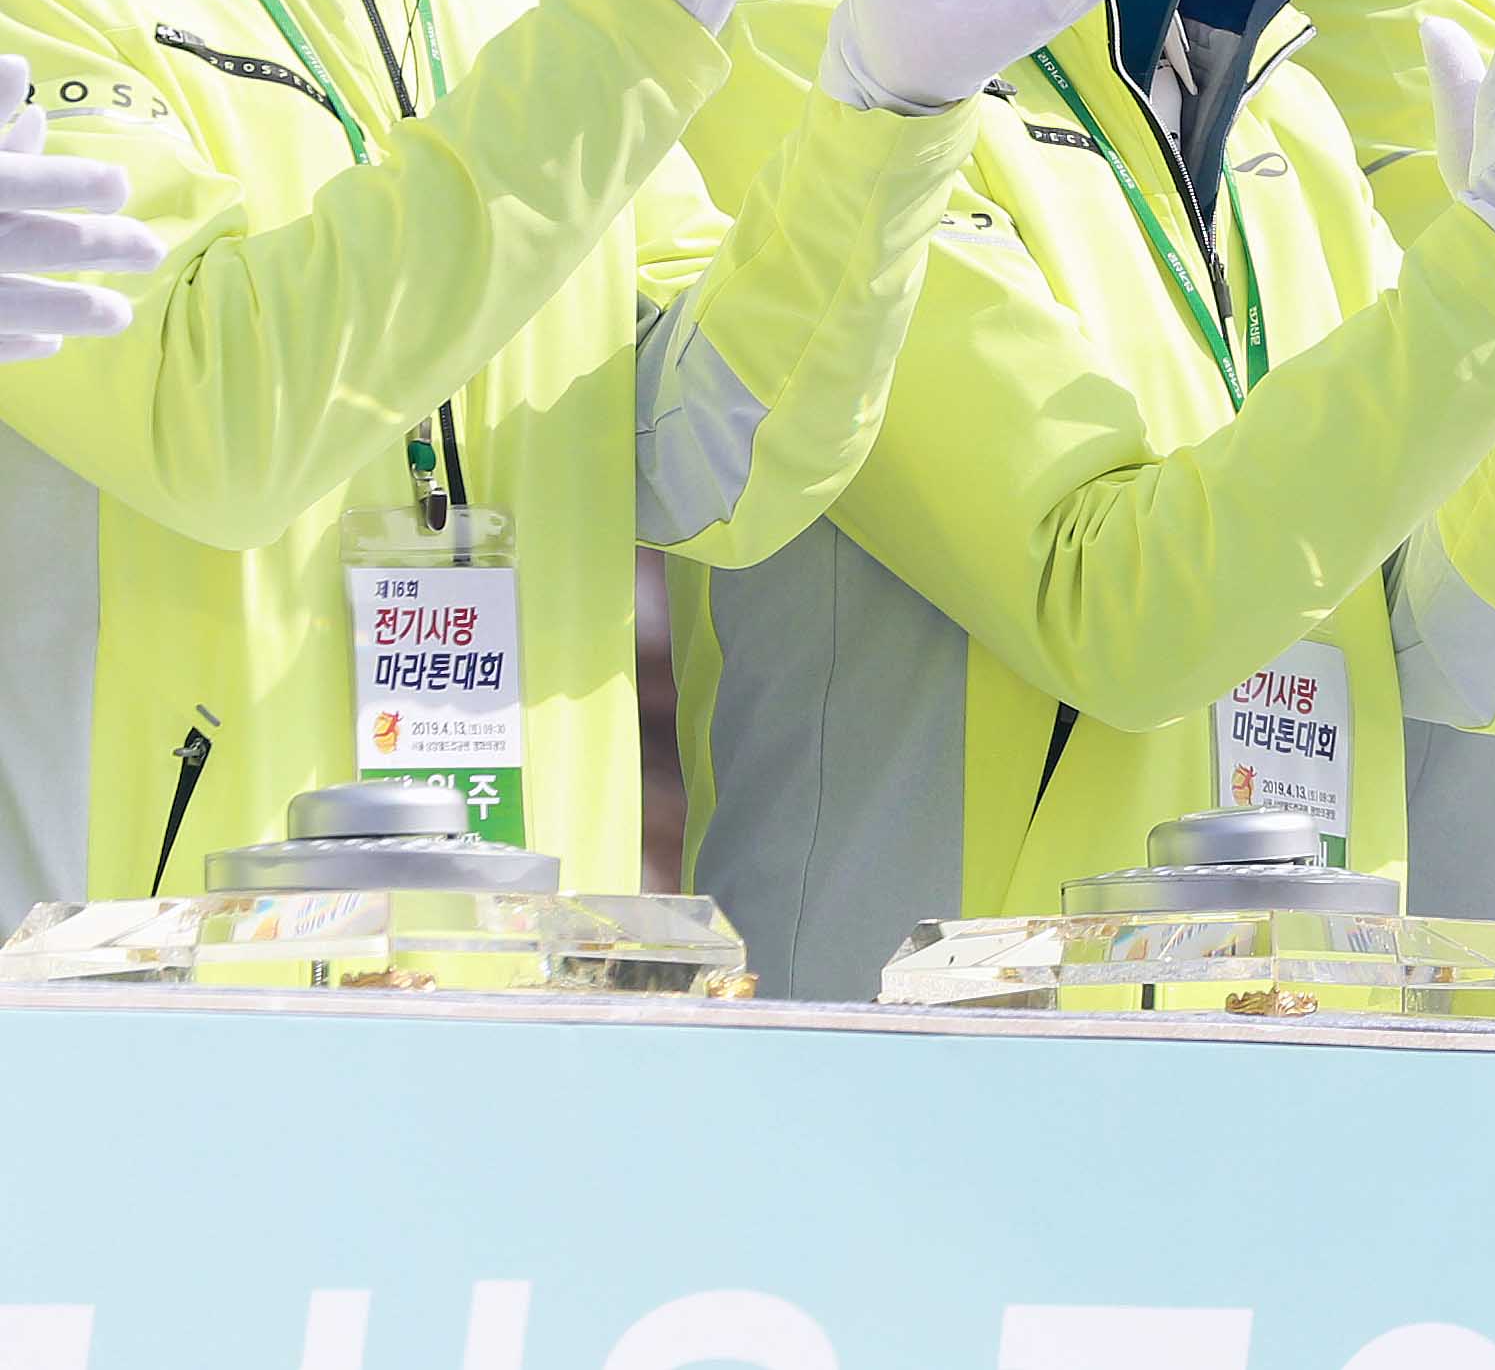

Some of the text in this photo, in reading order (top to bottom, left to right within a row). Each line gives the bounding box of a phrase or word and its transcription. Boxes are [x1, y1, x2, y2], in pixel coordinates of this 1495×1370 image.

[374, 580, 419, 600] 제16회
[374, 606, 478, 646] 전기사랑
[373, 651, 504, 691] 마라톤대회
[1232, 711, 1338, 762] 마라톤대회
